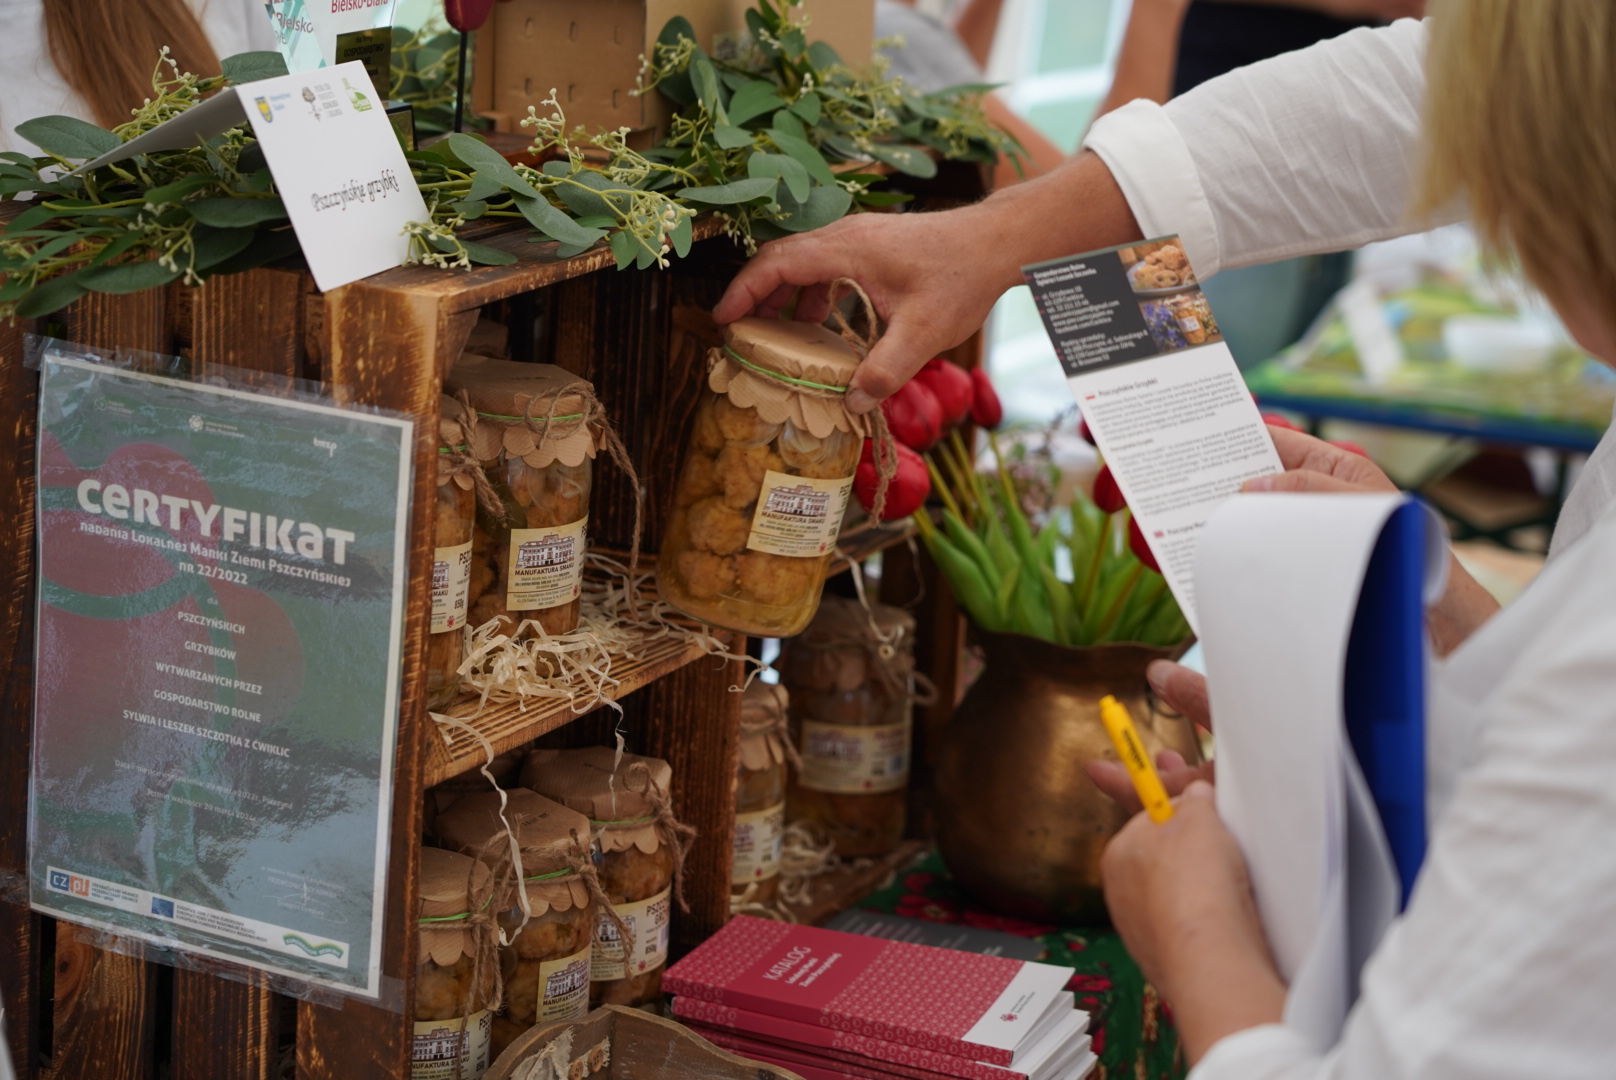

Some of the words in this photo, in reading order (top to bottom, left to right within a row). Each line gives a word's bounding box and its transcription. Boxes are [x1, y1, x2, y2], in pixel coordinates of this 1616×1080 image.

[190, 542, 228, 560] Marki
[230, 551, 265, 569] Ziemi
[197, 564, 248, 585] 22/2022
[514, 567, 559, 576] MANUFAKTURA
[559, 562, 575, 571] SMAKU
[177, 611, 245, 635] PSZCZYŃSKICH
[184, 640, 236, 660] GRZYBKÓW
[155, 661, 232, 688] WYTWARZANYCH
[233, 680, 263, 695] PRZEZ
[153, 689, 230, 715] GOSPODARSTWO
[231, 707, 262, 723] ROLNE
[123, 709, 156, 726] SYLWIA
[163, 718, 195, 735] LESZEK
[196, 727, 242, 747] SZCZOTKA
[244, 739, 251, 748] Z
[252, 739, 290, 757] ĆWIKLIC
[762, 945, 812, 981] KATALOG
[543, 990, 579, 1006] MANUFAKTURA
